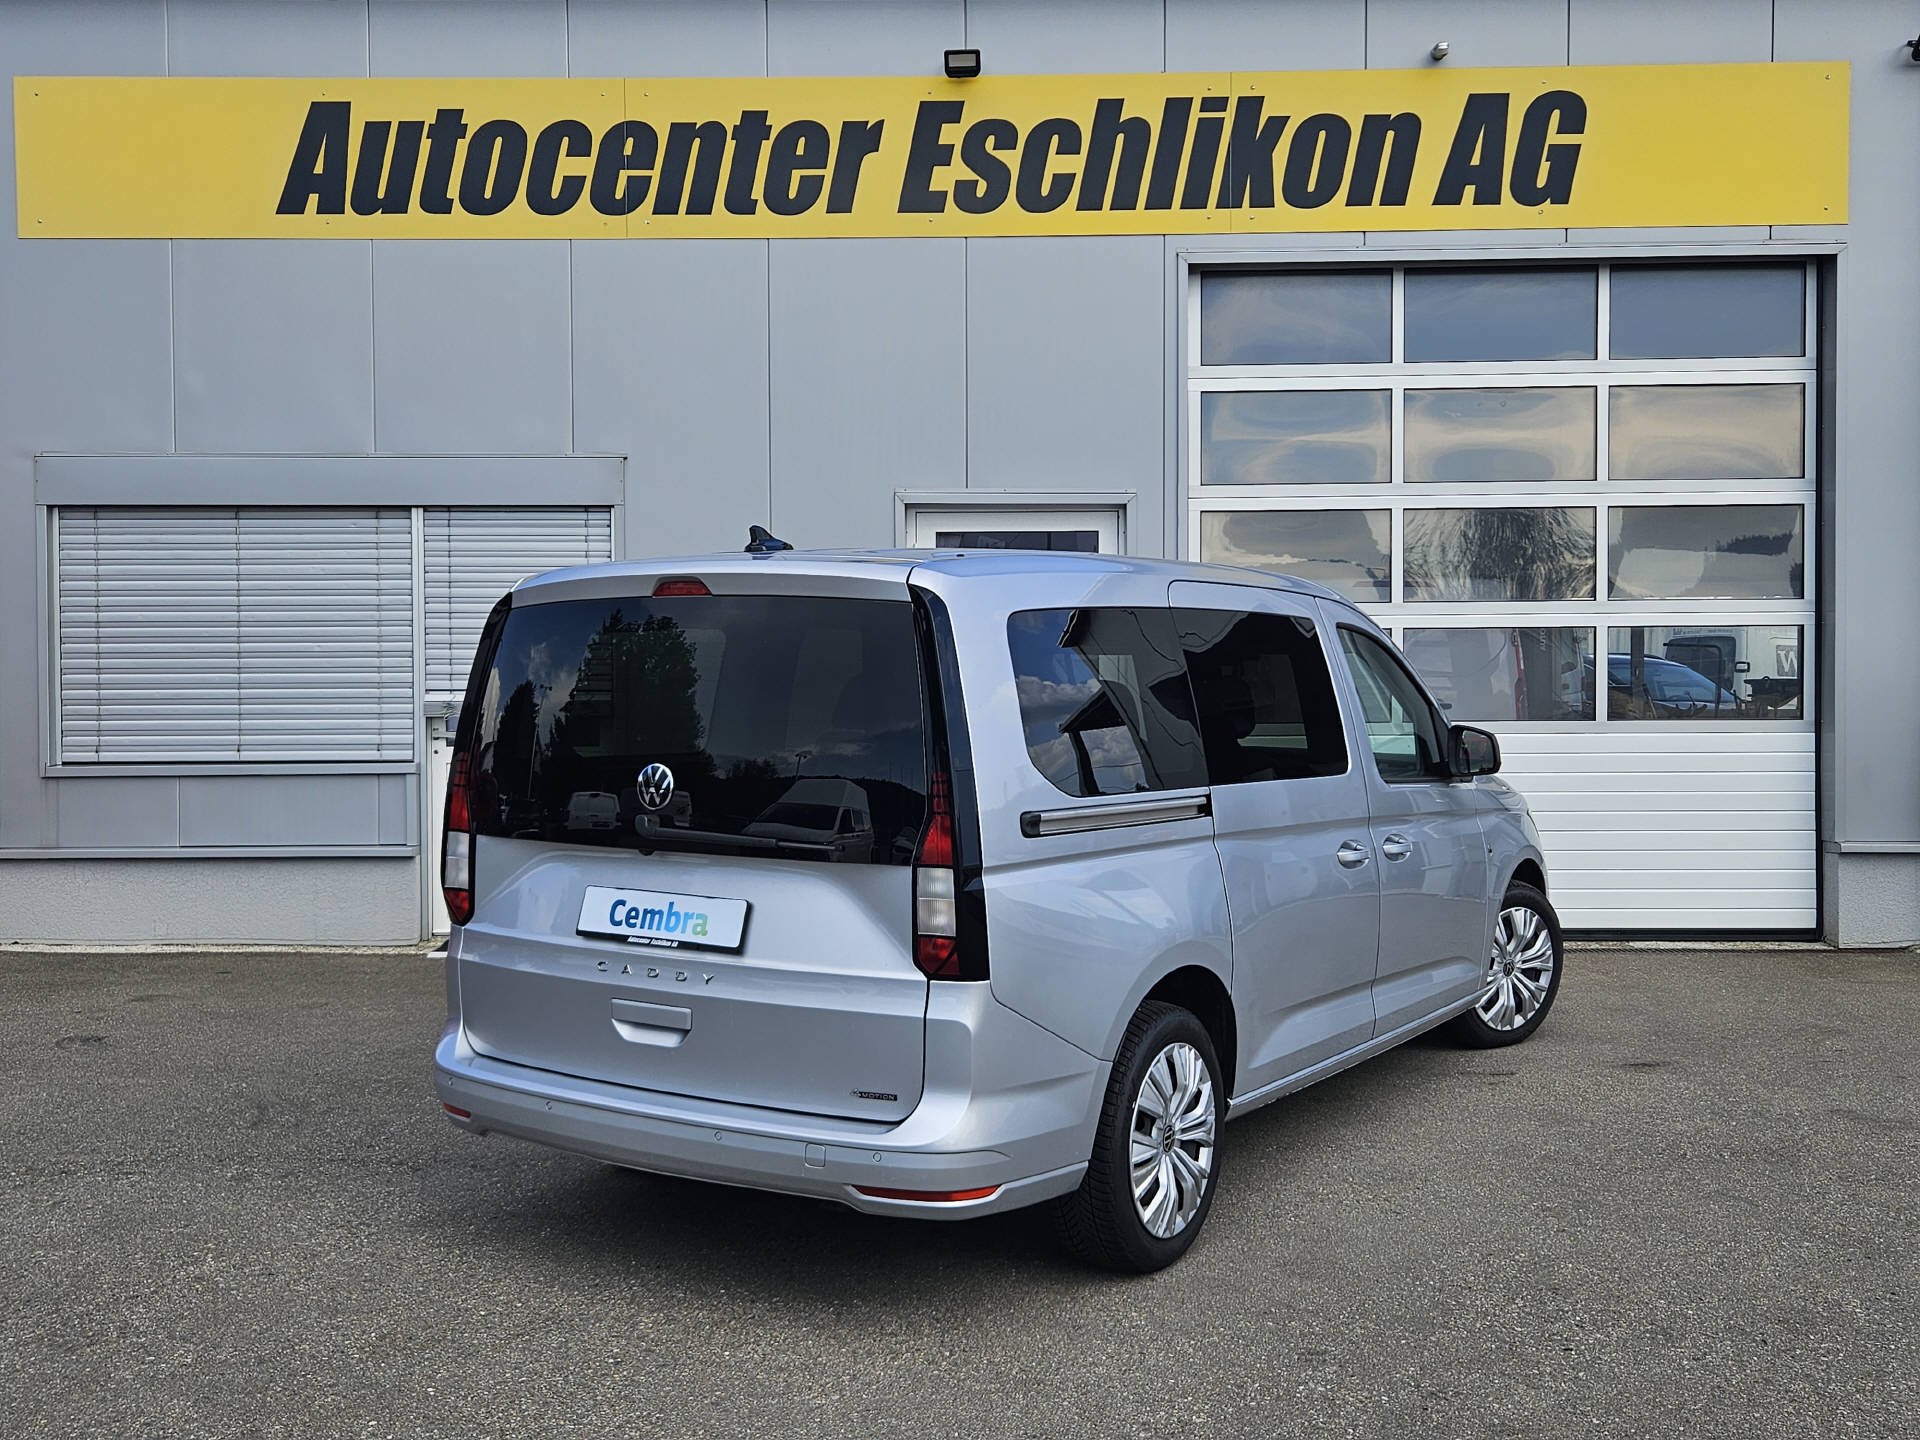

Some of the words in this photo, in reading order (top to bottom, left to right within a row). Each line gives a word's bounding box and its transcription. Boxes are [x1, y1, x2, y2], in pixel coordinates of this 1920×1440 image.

[275, 101, 885, 217] Autocenter
[897, 92, 1422, 214] Eschlikon
[1431, 89, 1589, 207] AG
[609, 899, 709, 937] Cembra
[596, 961, 715, 985] CADDY
